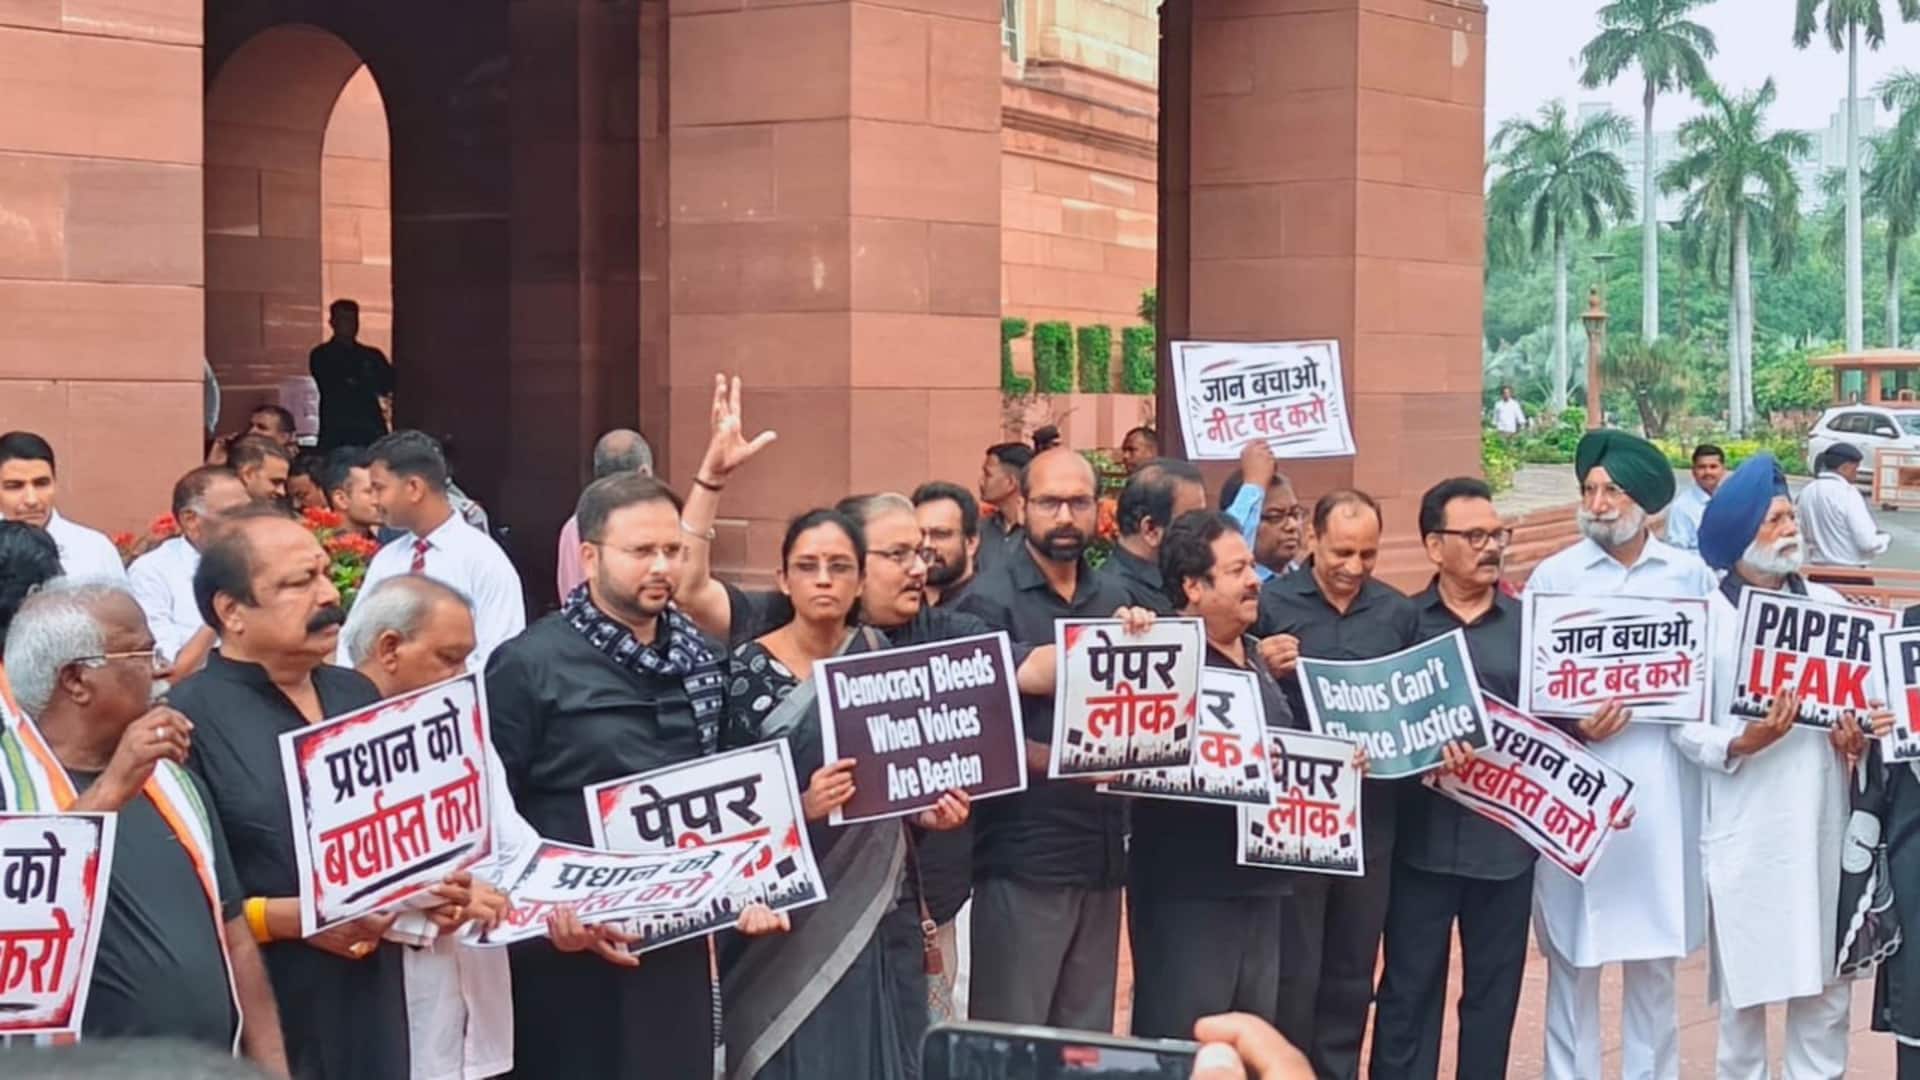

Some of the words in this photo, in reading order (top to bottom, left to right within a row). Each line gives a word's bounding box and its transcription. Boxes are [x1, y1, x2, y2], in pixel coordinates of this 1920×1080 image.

[1200, 374, 1246, 402] जान
[1251, 356, 1326, 396] बचाओ,
[1203, 407, 1249, 443] नीट
[1249, 404, 1285, 435] बंद
[1286, 392, 1327, 429] करो
[1551, 626, 1607, 653] जान
[1612, 611, 1697, 650] बचाओ,
[1755, 602, 1875, 662] PAPER
[833, 665, 931, 710] Democracy
[929, 648, 996, 693] Bleeds
[1087, 630, 1183, 690] पेपर
[1316, 675, 1391, 712] Batons
[1391, 657, 1449, 705] Can't
[1547, 659, 1598, 699] नीट
[1604, 658, 1641, 693] बंद
[1645, 651, 1693, 688] करो
[1748, 648, 1871, 710] LEAK
[866, 713, 922, 754] When
[918, 703, 981, 744] Voices
[1086, 682, 1179, 739] लीक
[1400, 704, 1476, 754] Justice
[325, 724, 419, 804] प्रधान
[422, 697, 463, 763] को
[887, 763, 921, 801] Are
[917, 752, 983, 795] Beaten
[1271, 737, 1344, 799] पेपर
[630, 773, 763, 848] पेपर
[1267, 786, 1341, 838] लीक
[1568, 763, 1607, 806] को
[319, 790, 431, 886] बर्खास्त
[430, 757, 482, 842] करो
[1543, 796, 1597, 853] करो
[3, 831, 67, 904] को
[554, 861, 669, 890] प्रधान
[669, 850, 723, 873] को
[635, 871, 714, 902] करो
